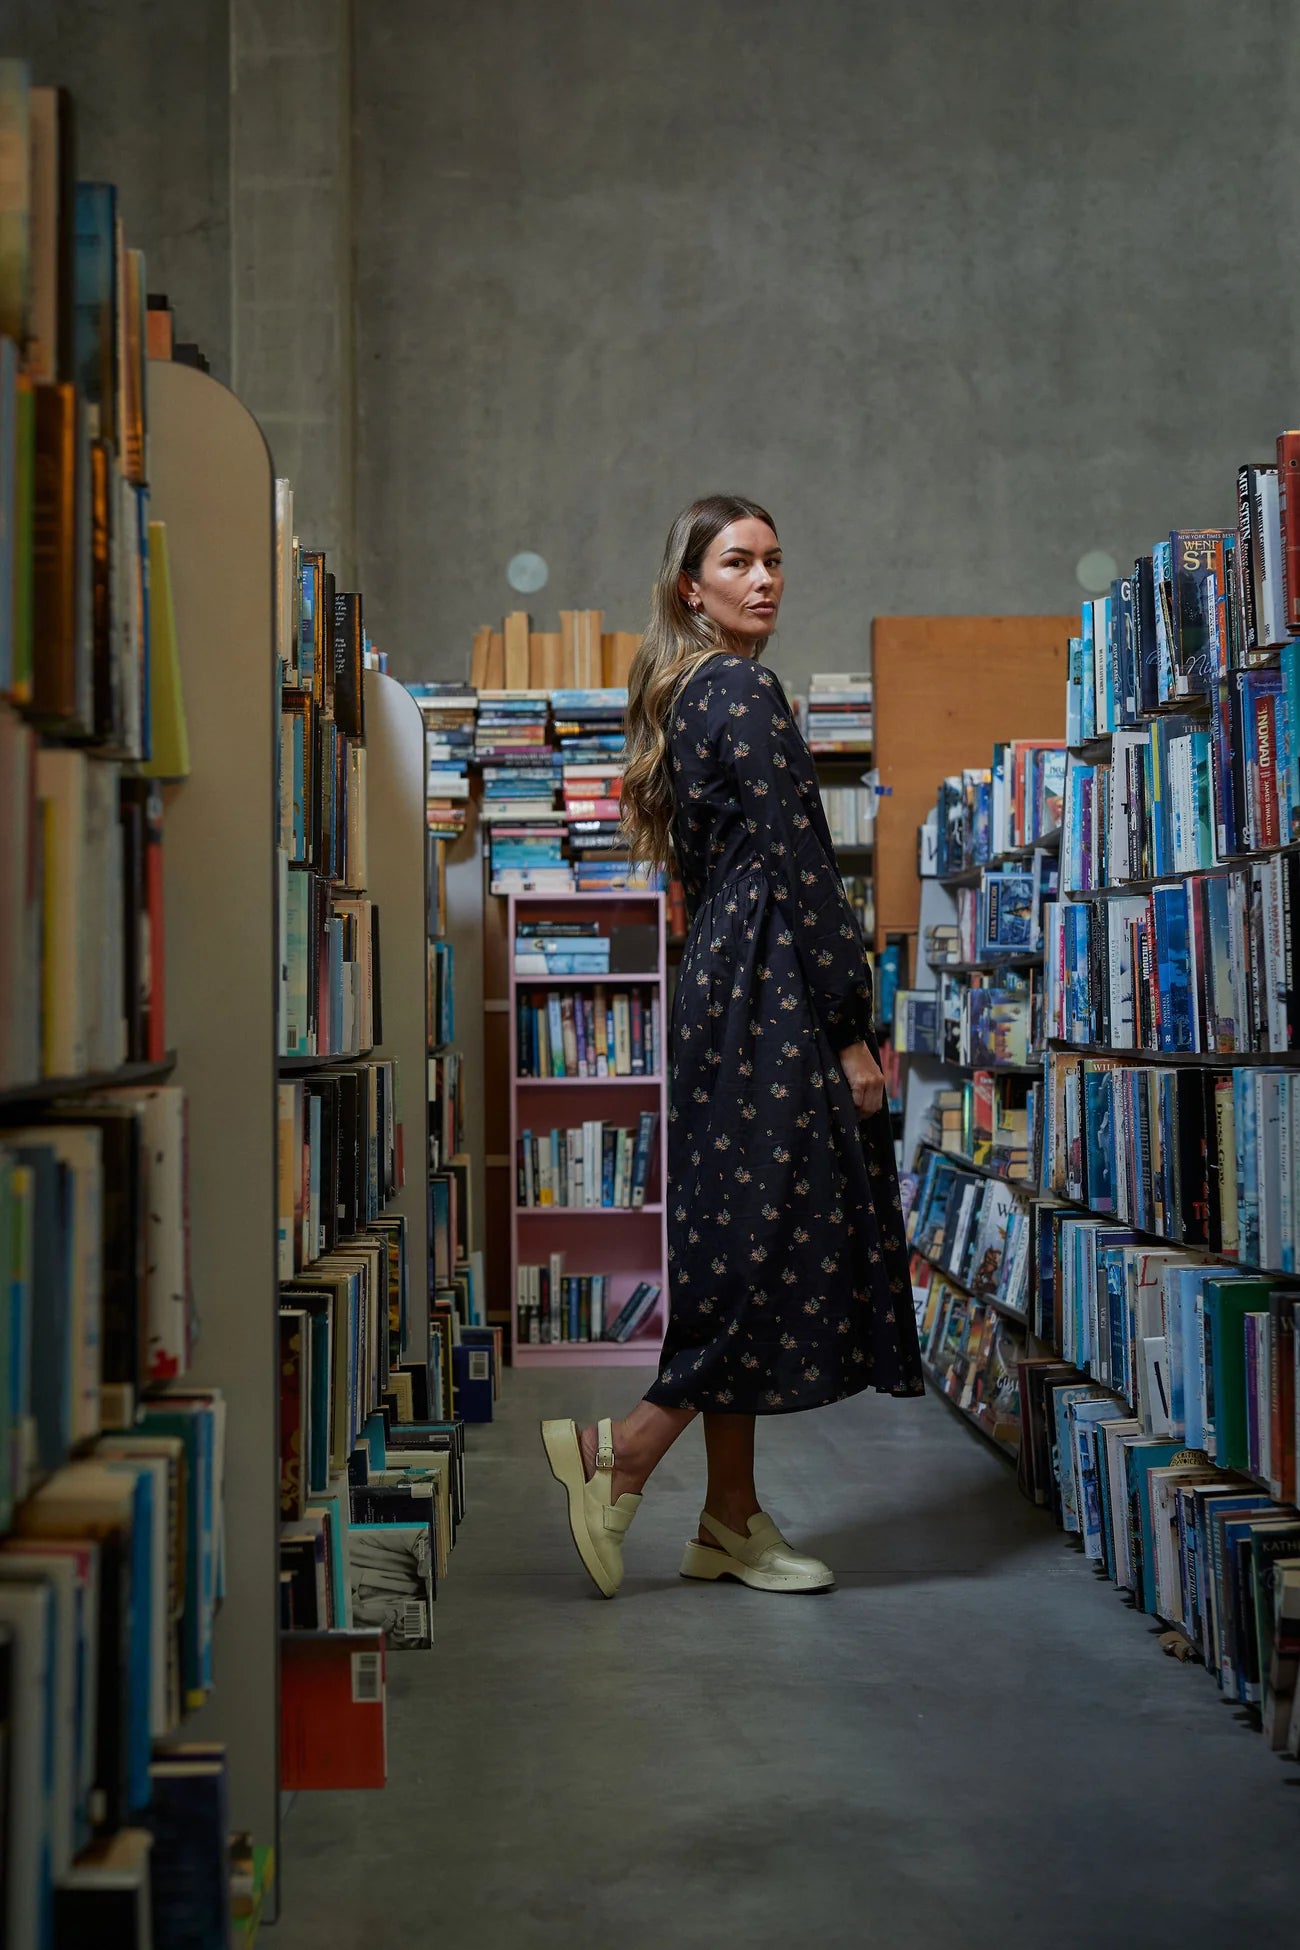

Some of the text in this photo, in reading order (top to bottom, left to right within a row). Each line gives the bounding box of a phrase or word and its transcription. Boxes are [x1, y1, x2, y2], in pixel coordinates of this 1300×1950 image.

[1240, 500, 1251, 539] STEIN
[1258, 714, 1271, 767] NOMAD
[1264, 804, 1272, 836] SWALLOW
[1272, 904, 1281, 957] MONEY
[1282, 857, 1294, 992] SOMEONE ELSE'S MONEY
[1217, 1149, 1225, 1186] Gray
[1262, 1540, 1299, 1552] KATH
[1187, 1551, 1198, 1606] DECEPTIONS
